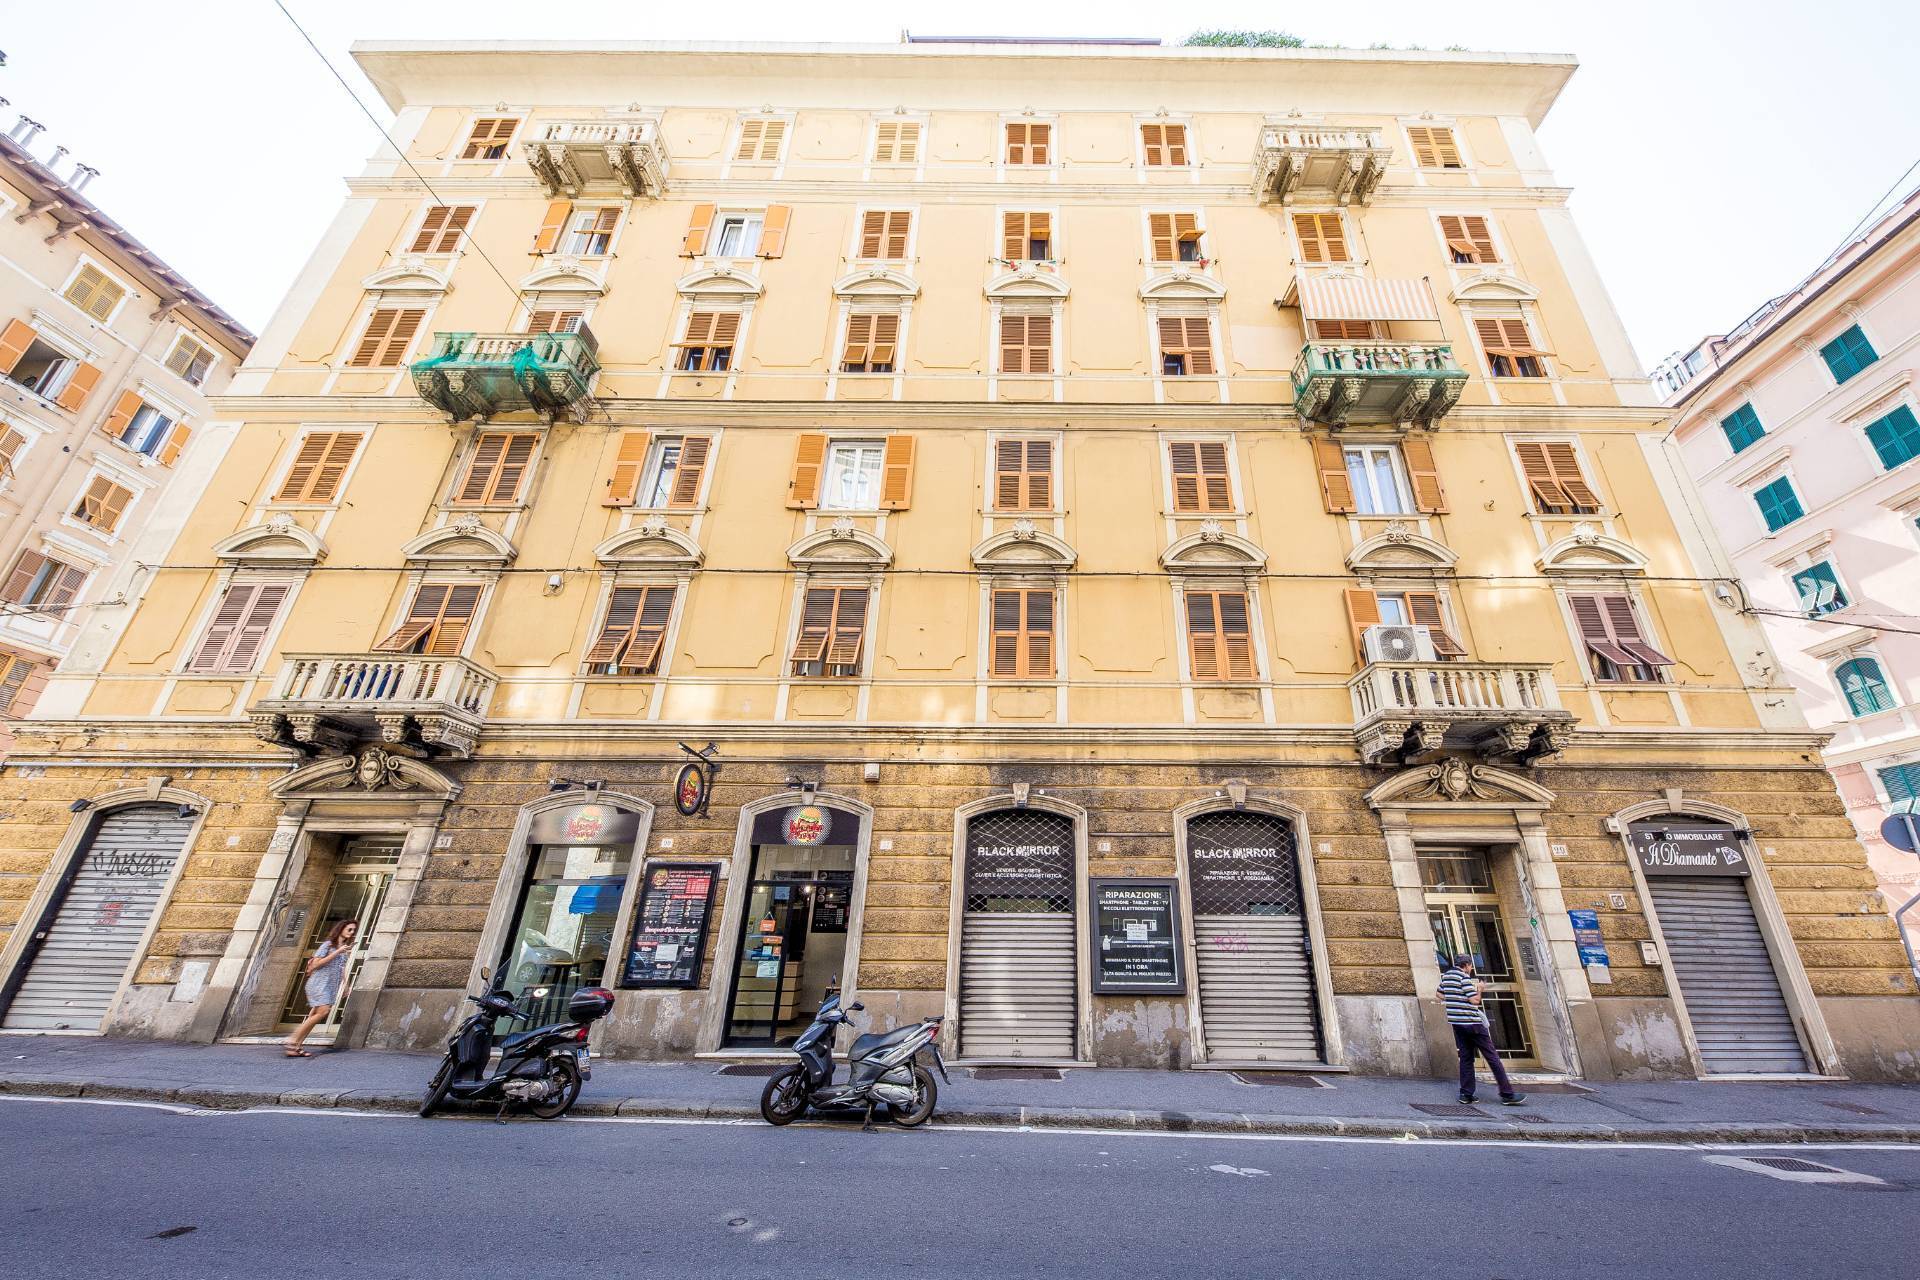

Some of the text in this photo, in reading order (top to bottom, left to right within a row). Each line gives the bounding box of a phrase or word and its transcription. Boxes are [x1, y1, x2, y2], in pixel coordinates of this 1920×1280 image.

[1644, 832, 1724, 841] STO IMMOBILIARE
[977, 845, 1060, 857] BLACK MIRROR
[1194, 847, 1276, 859] BLACK MIRROR
[1105, 891, 1162, 899] RIPARAZIONI:
